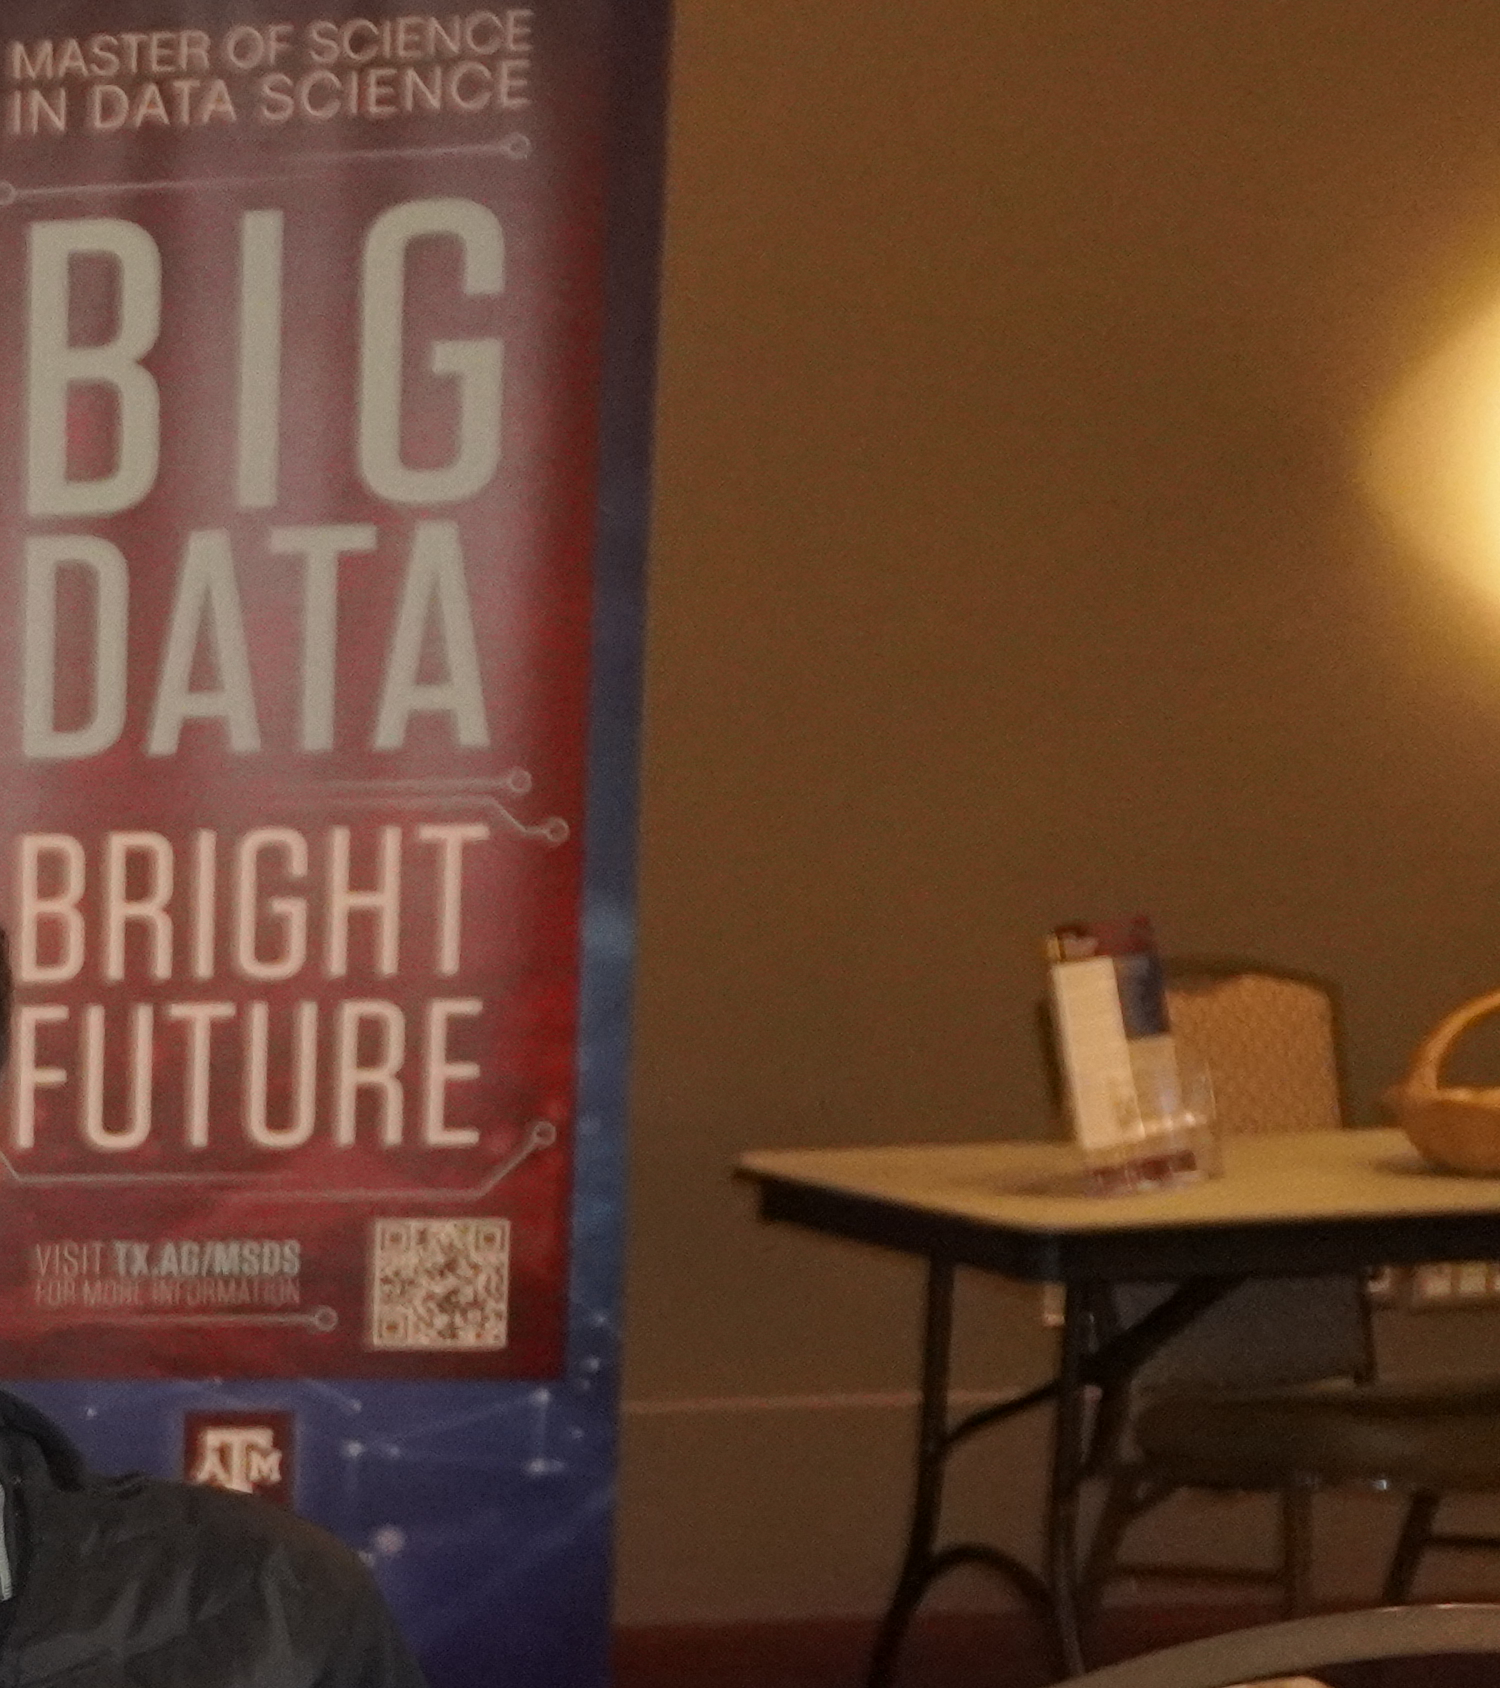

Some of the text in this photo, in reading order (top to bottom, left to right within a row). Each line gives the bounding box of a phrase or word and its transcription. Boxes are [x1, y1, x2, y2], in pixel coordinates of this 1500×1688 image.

[9, 9, 533, 80] MASTER OF SCIENCE
[11, 59, 532, 135] IN DATA SCIENCE
[27, 198, 505, 517] BIG
[22, 520, 490, 759] DATA
[17, 824, 490, 985] BRIGHT
[12, 998, 484, 1151] FUTURE
[35, 1241, 102, 1277] VISIT
